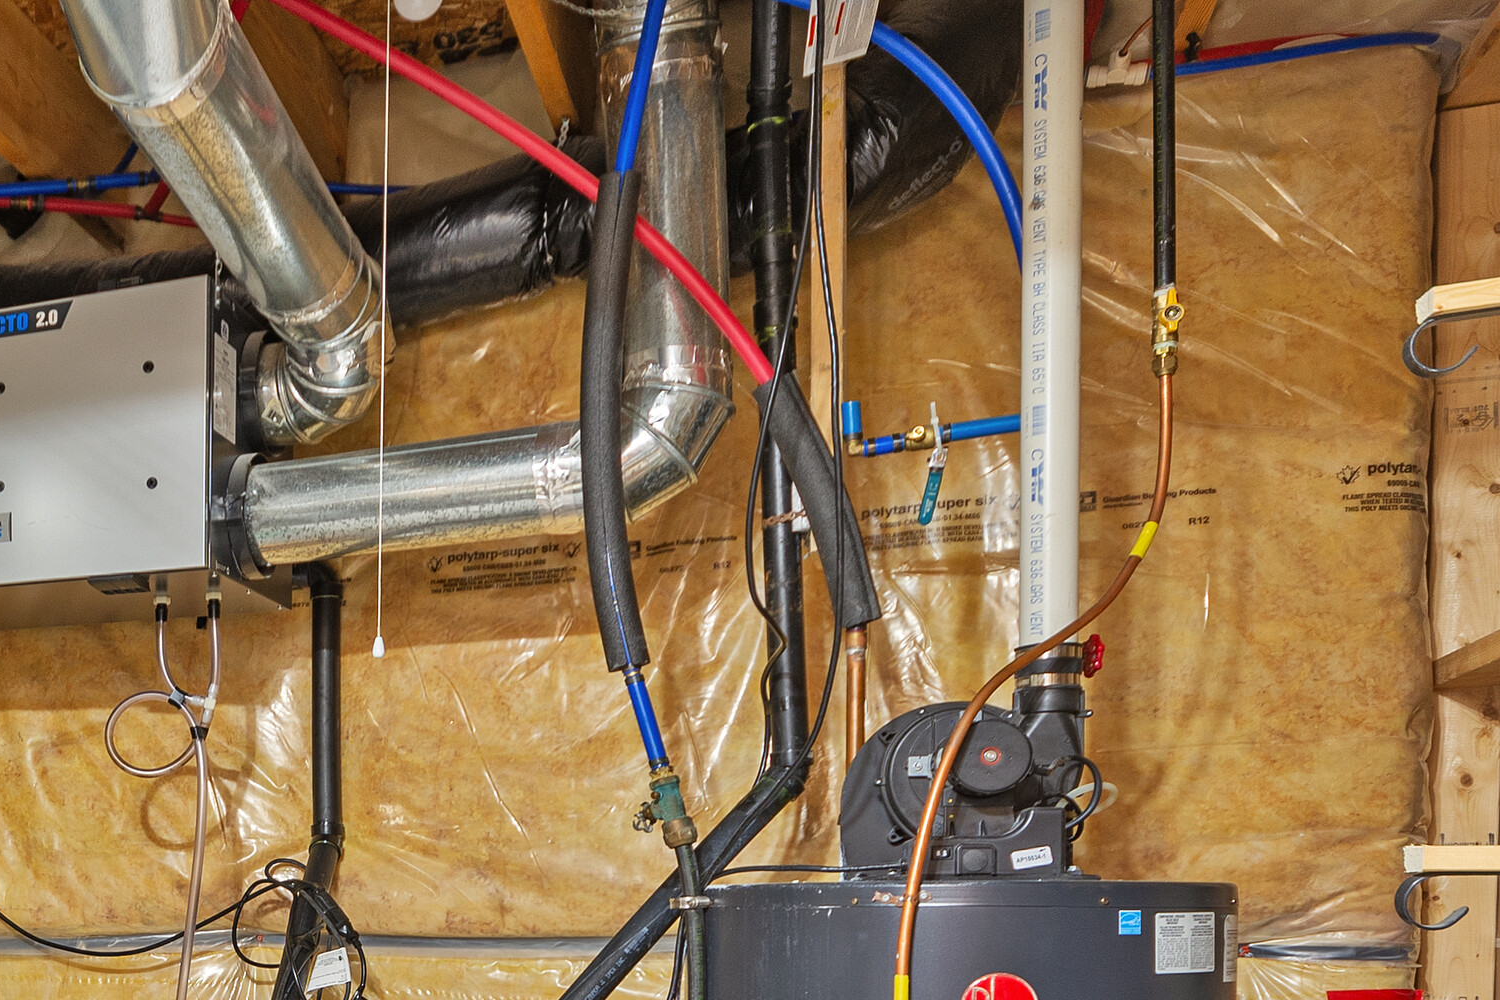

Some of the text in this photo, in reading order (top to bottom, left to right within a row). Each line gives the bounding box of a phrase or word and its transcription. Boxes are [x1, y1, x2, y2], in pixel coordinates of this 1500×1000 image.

[1033, 119, 1047, 161] SYSTEM
[1032, 217, 1046, 243] VENT
[1032, 249, 1046, 278] TYPE
[1032, 283, 1046, 297] BH
[35, 309, 59, 328] 2.0
[1032, 302, 1046, 336] CLASS
[975, 495, 997, 506] six
[1102, 487, 1217, 503] Guardian Products
[1188, 516, 1210, 525] R12
[1030, 513, 1044, 554] SYSTEM
[447, 542, 560, 564] polytarp-super six
[1030, 584, 1044, 605] GAS
[1030, 610, 1043, 636] VENT
